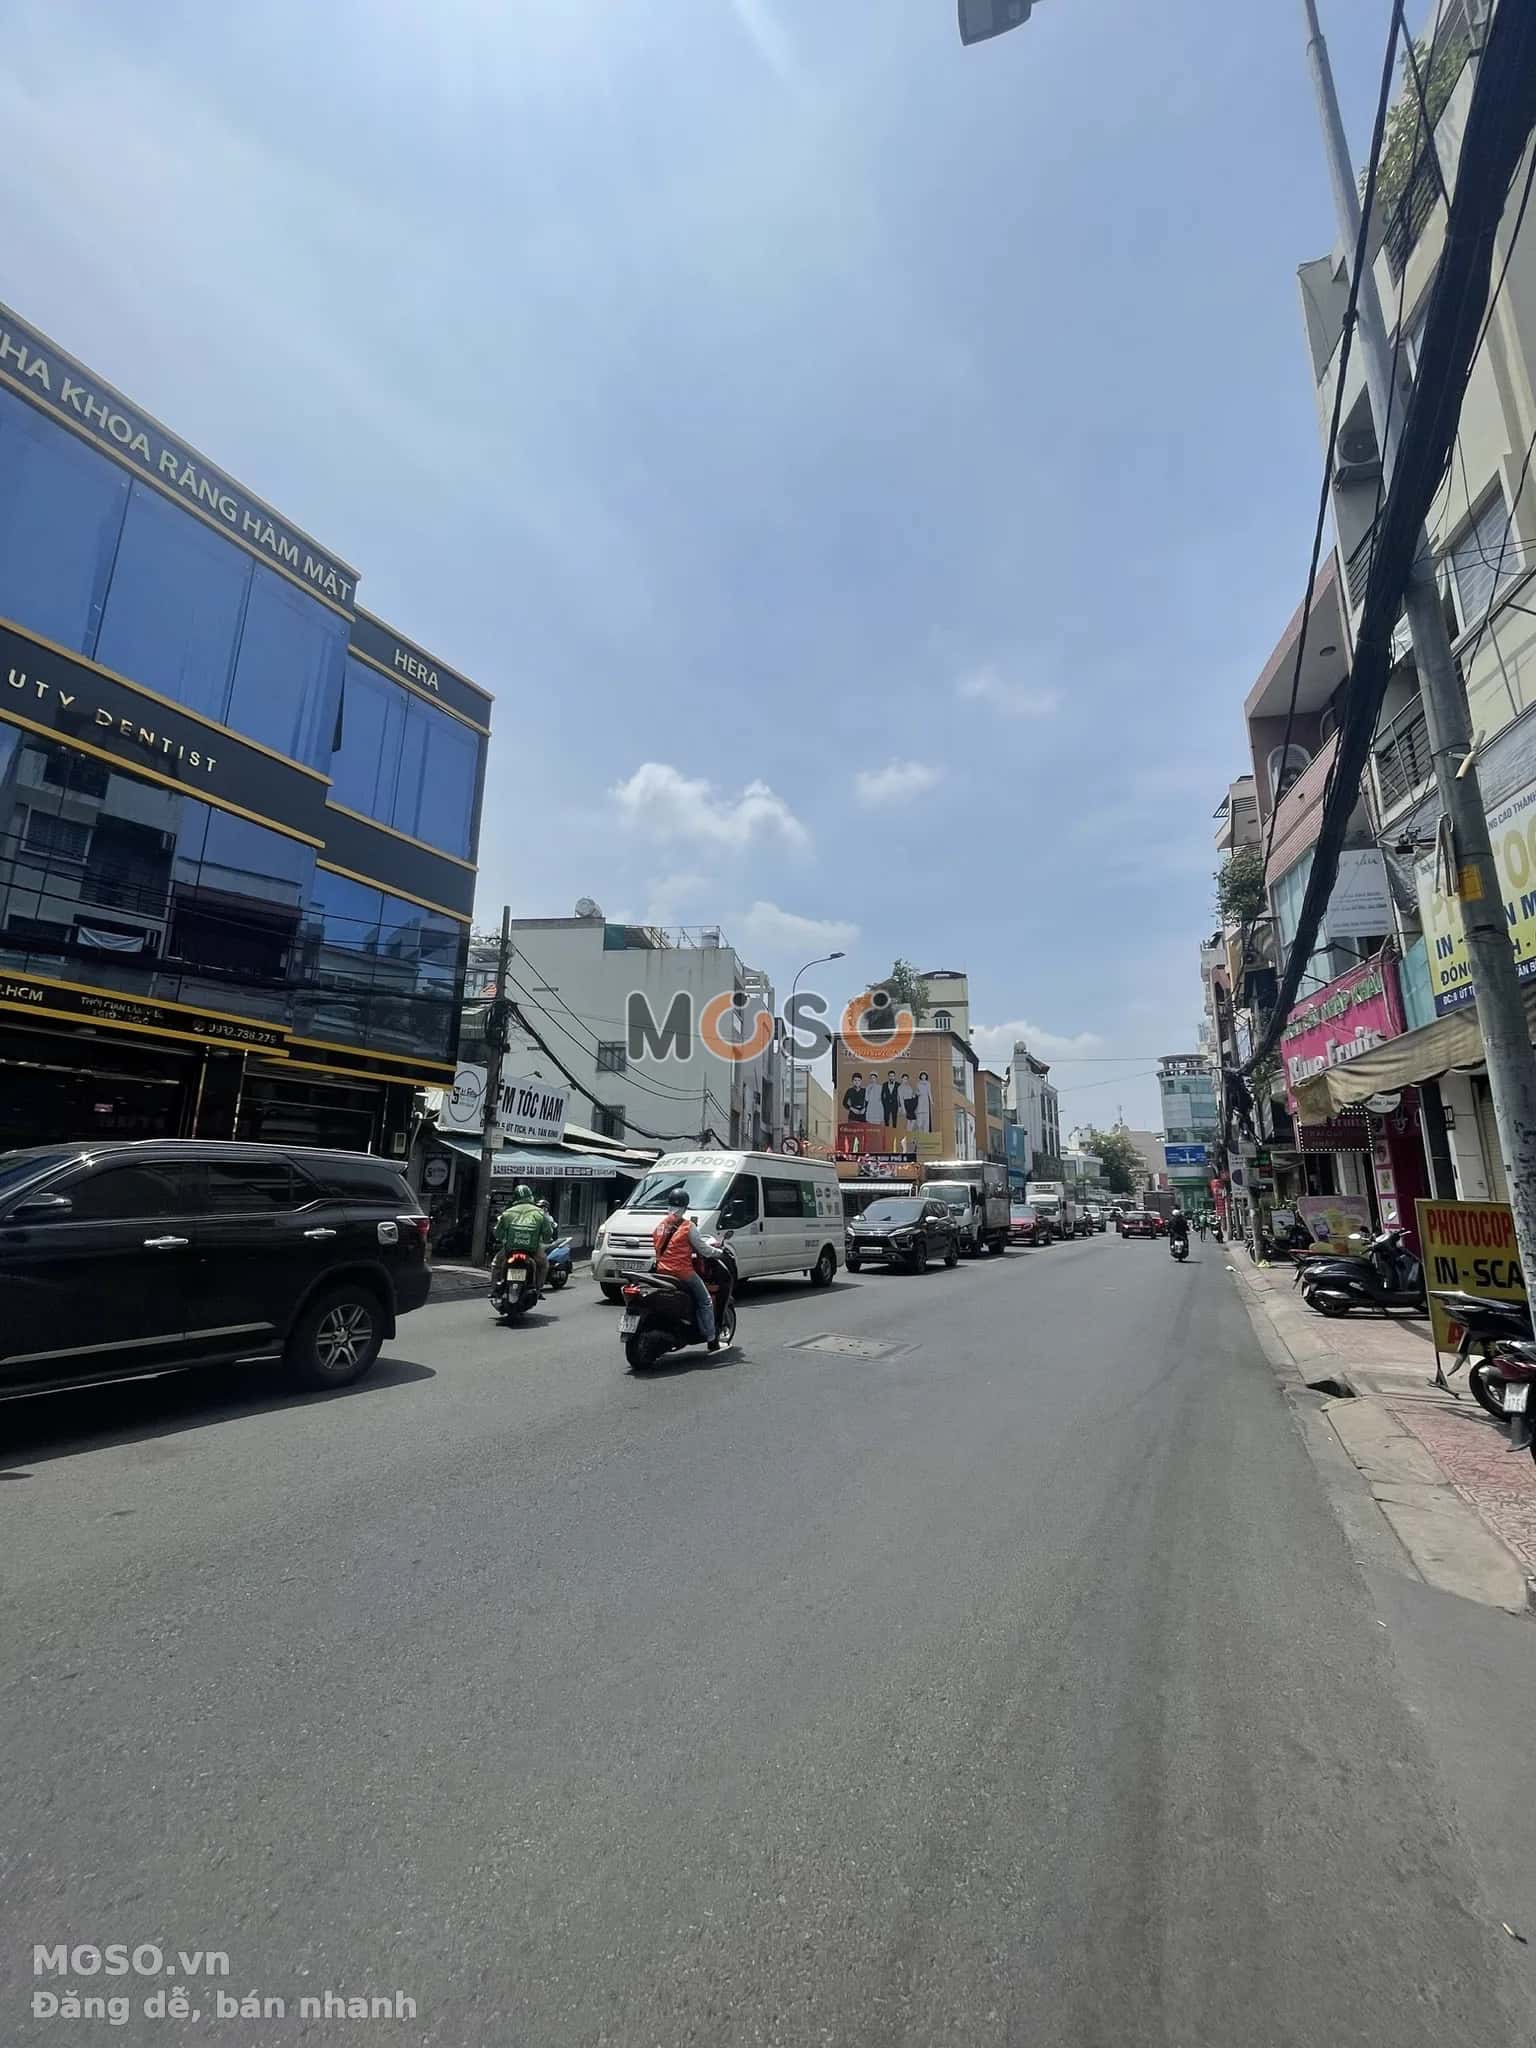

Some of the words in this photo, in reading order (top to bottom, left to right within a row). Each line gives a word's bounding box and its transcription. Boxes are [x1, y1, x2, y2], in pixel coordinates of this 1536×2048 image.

[0, 330, 50, 391] HA
[60, 377, 151, 462] KHOA
[159, 449, 238, 522] RĂNG
[243, 510, 300, 568] HÀM
[304, 554, 351, 602] MẶT
[395, 649, 440, 692] HERA
[95, 708, 217, 772] DENTIST
[1435, 933, 1454, 960] IN
[0, 983, 43, 1001] .HCM
[517, 1086, 539, 1119] TÓC
[539, 1095, 564, 1122] NAM
[692, 1156, 737, 1168] FOOD
[1426, 1207, 1512, 1249] PHOTOCOP
[1435, 1256, 1459, 1285] IN
[1473, 1258, 1526, 1290] SCA
